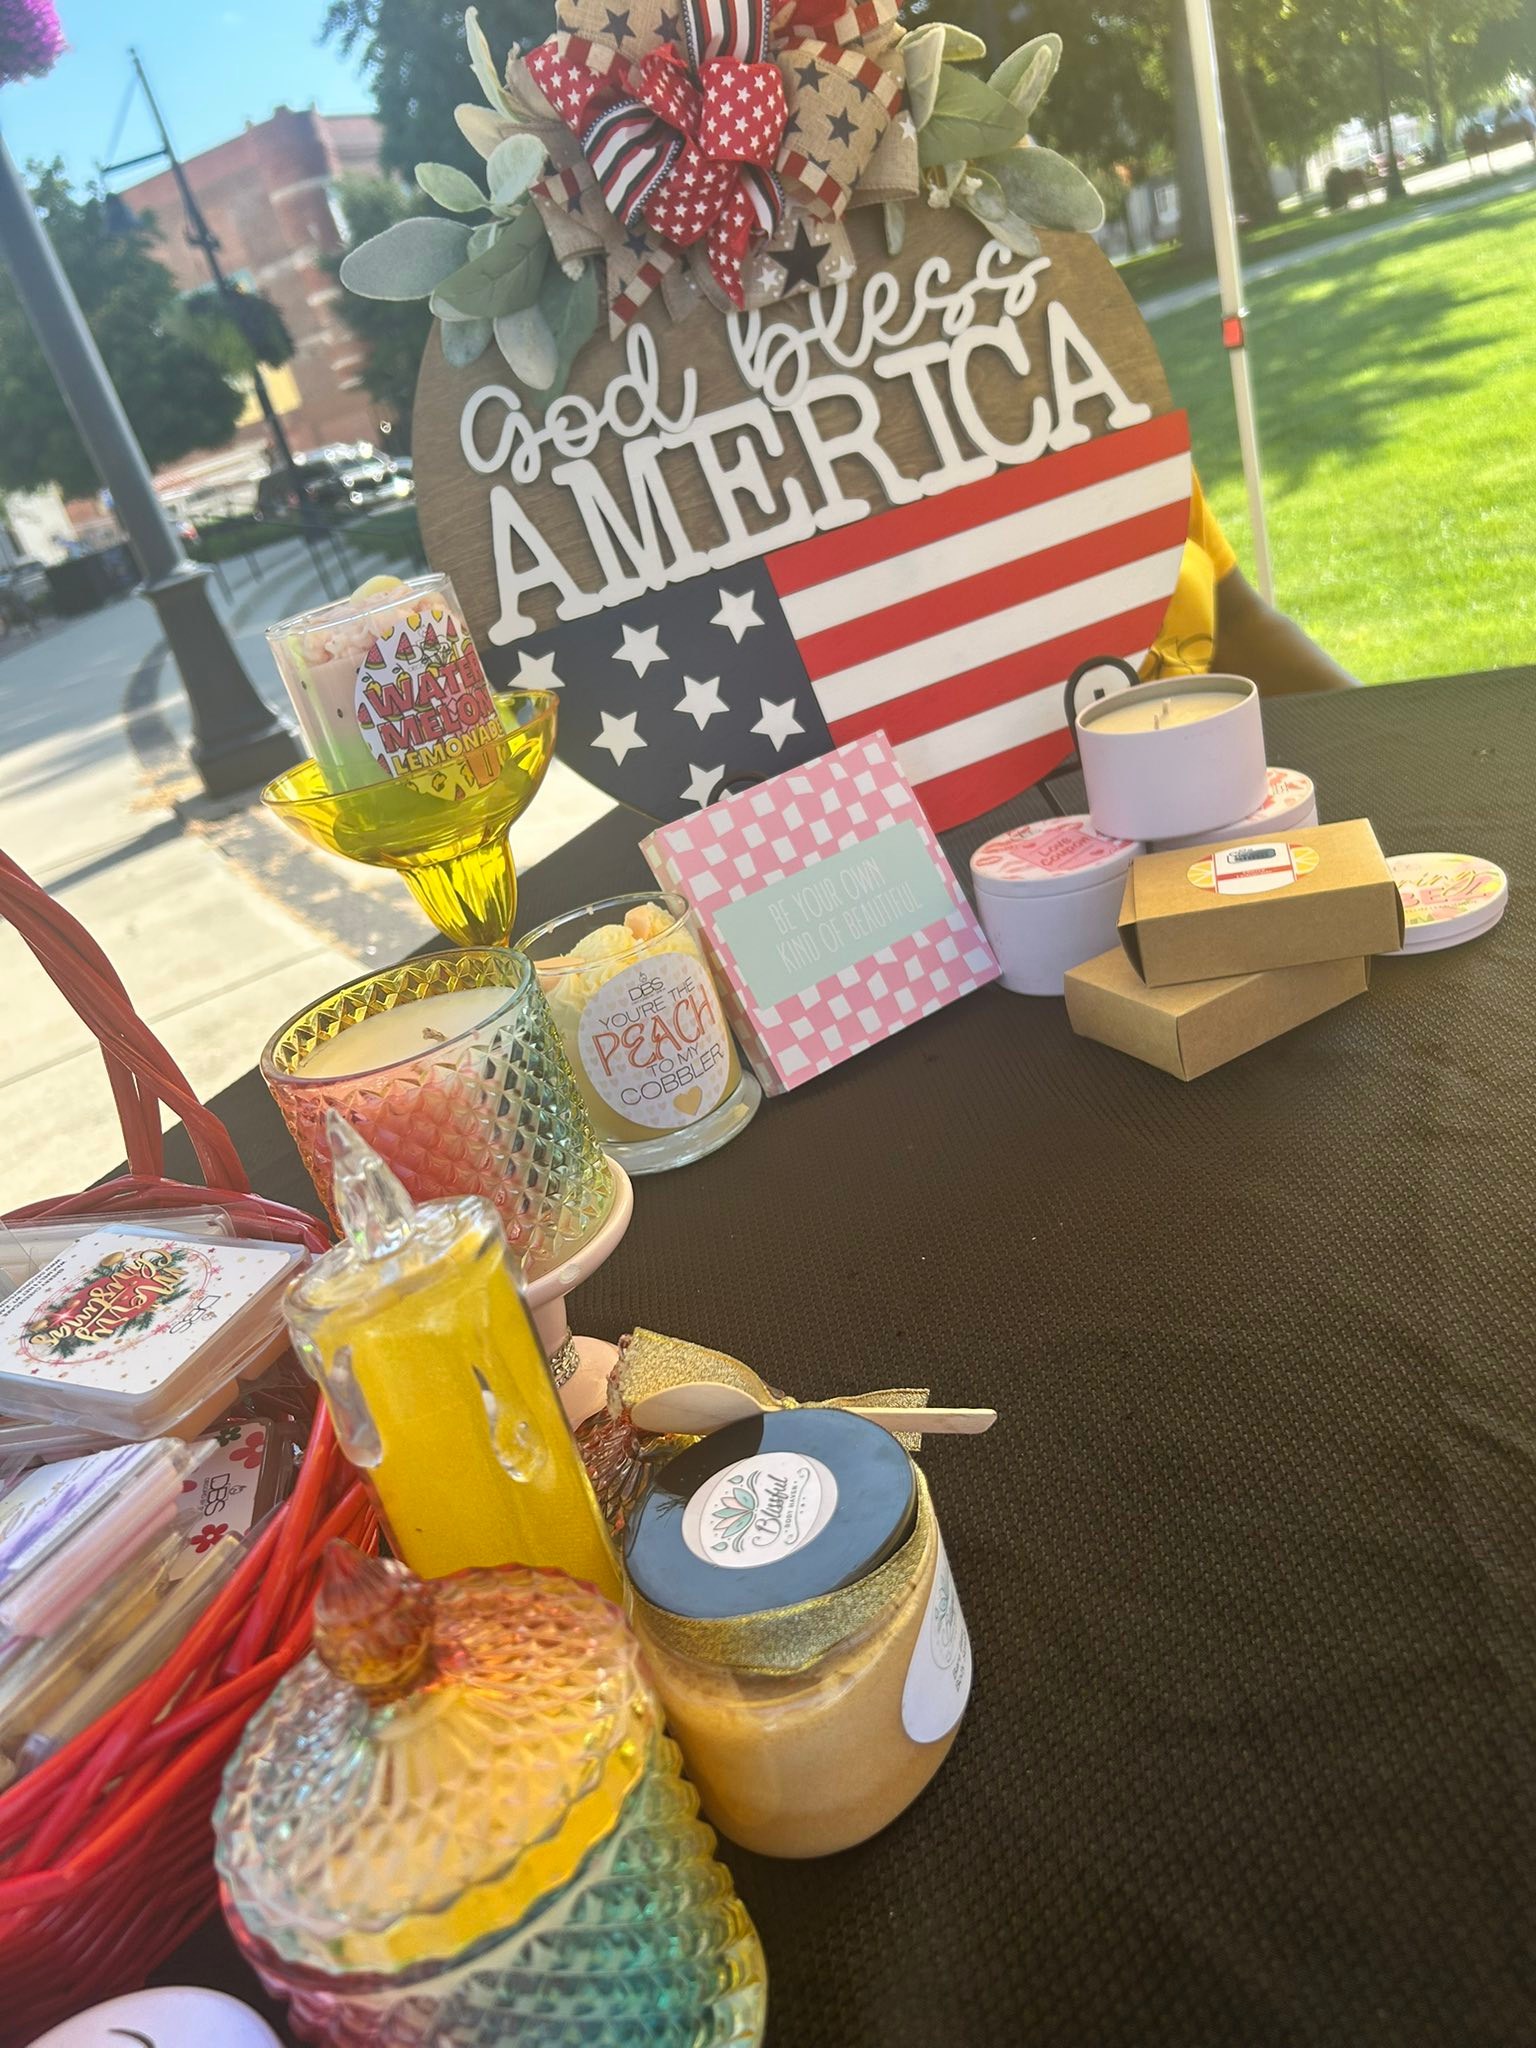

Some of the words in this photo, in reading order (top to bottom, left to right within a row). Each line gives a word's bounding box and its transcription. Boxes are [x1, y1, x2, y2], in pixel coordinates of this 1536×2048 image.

[728, 240, 1051, 410] bless
[489, 301, 1151, 646] AMERICA
[364, 651, 486, 718] WATER
[378, 687, 496, 752] MELON
[1038, 837, 1073, 857] LOVE
[767, 900, 797, 936] BE
[792, 878, 841, 922] YOUR
[840, 856, 887, 899] OWN
[775, 930, 821, 975] KIND
[820, 916, 845, 953] OF
[845, 881, 923, 942] BEAUTIFUL
[598, 994, 667, 1030] YOU'RE
[668, 976, 696, 1003] THE
[628, 976, 665, 1002] DBS
[592, 984, 716, 1077] PEACH
[647, 1058, 675, 1077] TO
[677, 1043, 701, 1067] MY
[620, 1043, 724, 1106] COBBLER
[28, 1249, 173, 1349] Christmas
[74, 1266, 188, 1343] Merry
[204, 1473, 230, 1516] DBS
[752, 1474, 789, 1547] Blissful
